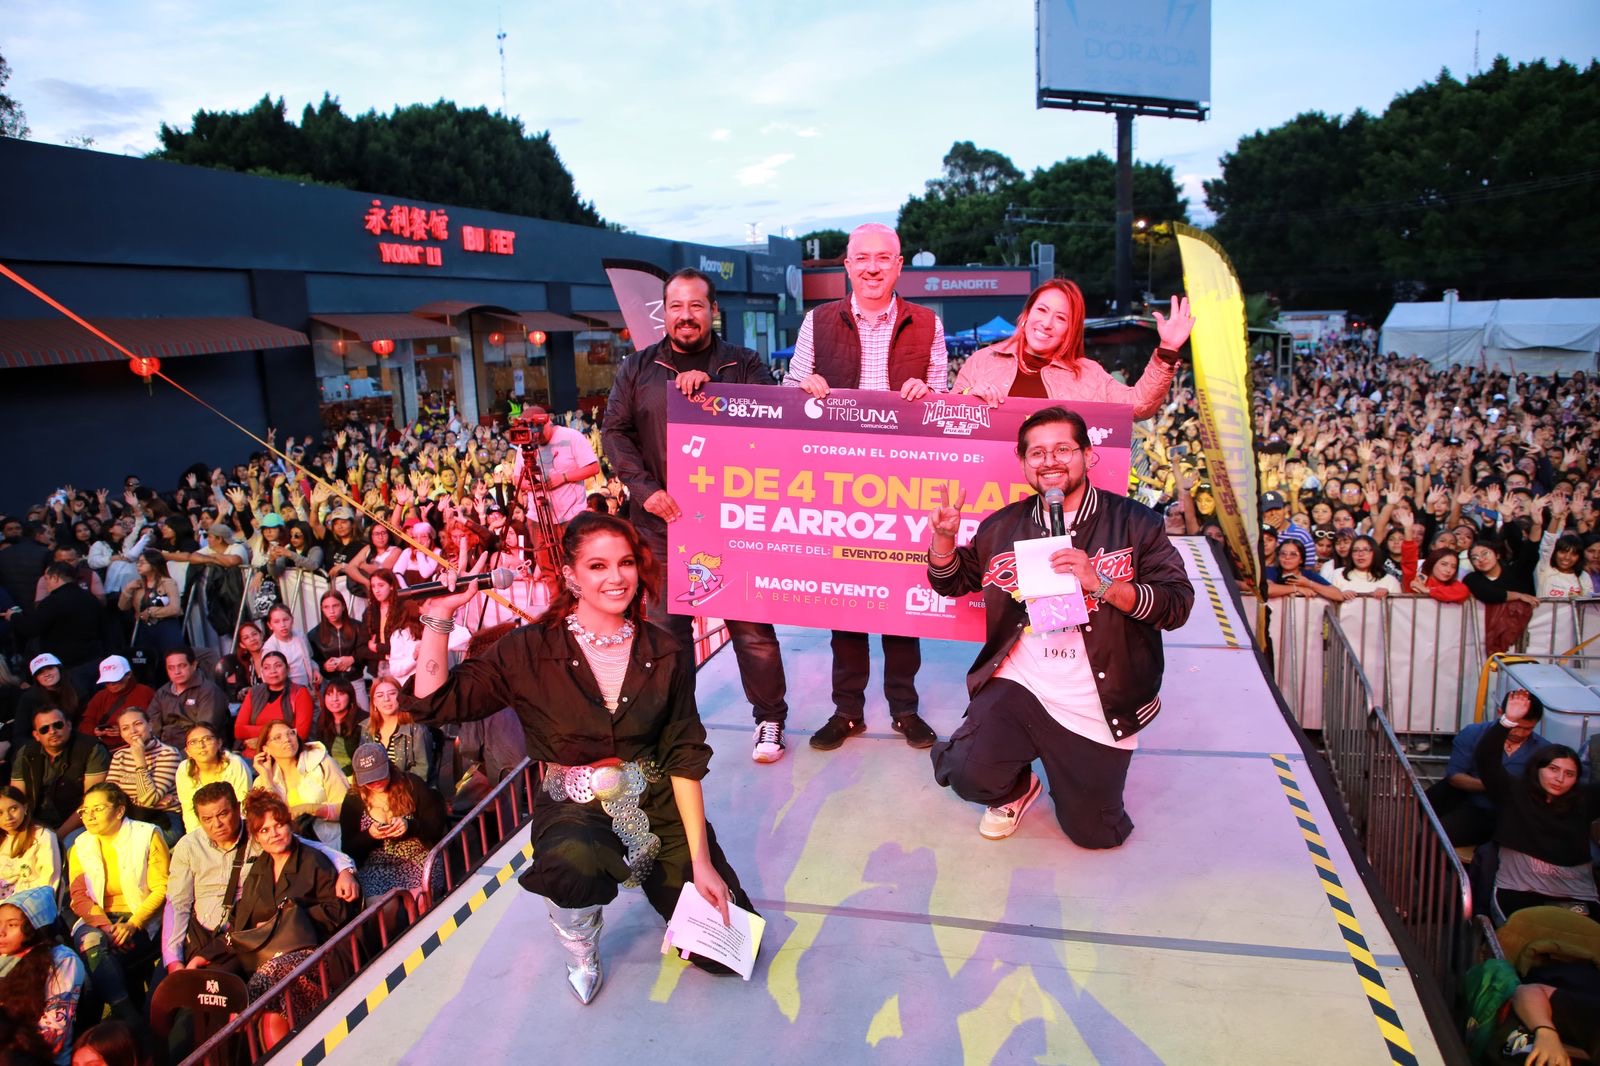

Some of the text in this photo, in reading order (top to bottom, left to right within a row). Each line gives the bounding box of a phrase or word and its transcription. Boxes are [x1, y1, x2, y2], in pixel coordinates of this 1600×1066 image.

[1085, 38, 1198, 66] DORADA
[941, 279, 998, 290] BANORTE
[729, 398, 757, 406] PUEBLA
[826, 398, 857, 407] GRUPO
[728, 404, 783, 419] 98.7FM
[826, 408, 898, 424] TRIBUNA
[802, 444, 985, 463] OTORGAN EL DONATIVO DE:
[723, 465, 780, 501] DE
[787, 469, 816, 503] 4
[824, 471, 1038, 513] TONELAD
[720, 502, 766, 532] DE
[771, 507, 897, 541] ARROZ
[903, 514, 929, 543] Y
[728, 539, 831, 556] COMO PARTE DEL:
[842, 548, 888, 560] EVENTO
[889, 551, 904, 562] 40
[755, 576, 890, 599] MAGNO EVENTO
[756, 592, 889, 610] A BENEFICIO DE:
[968, 600, 986, 608] PUEB
[1044, 647, 1076, 659] 1963
[197, 993, 228, 1008] TECATE
